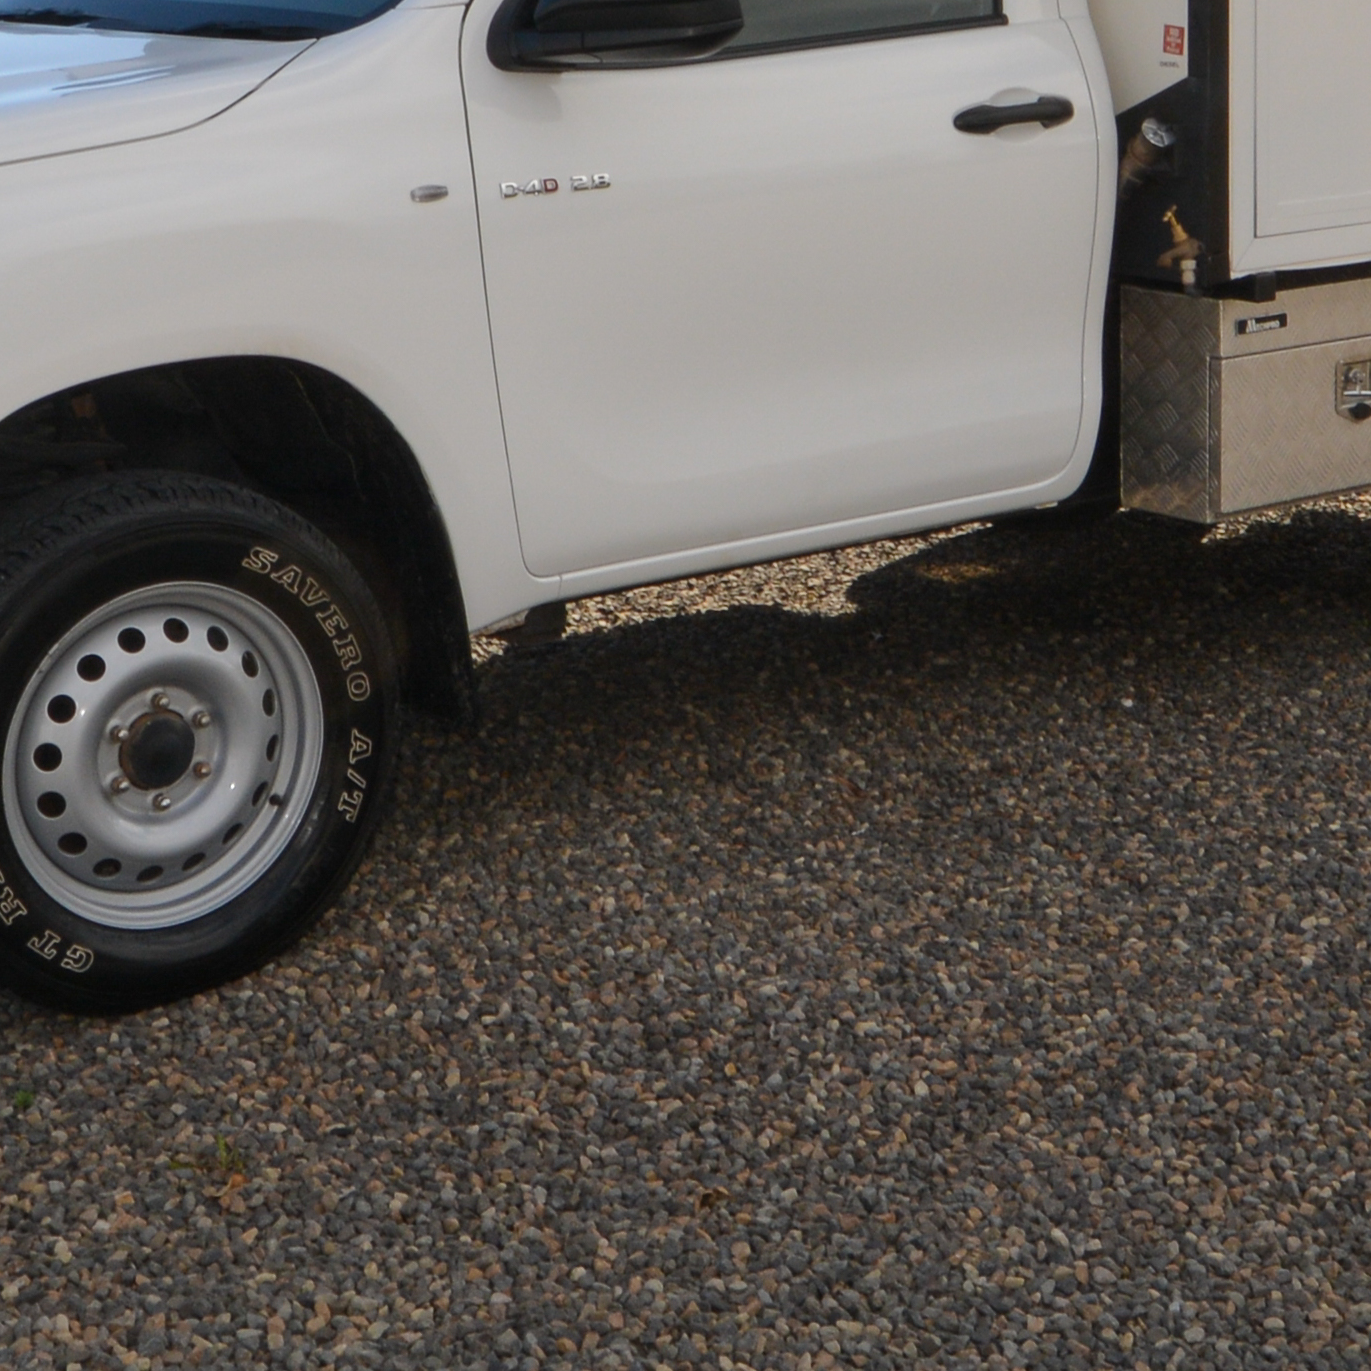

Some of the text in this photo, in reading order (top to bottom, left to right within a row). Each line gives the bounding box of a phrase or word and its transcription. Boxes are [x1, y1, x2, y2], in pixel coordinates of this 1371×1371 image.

[241, 545, 373, 823] SAVERO A/T
[27, 929, 95, 975] GT
